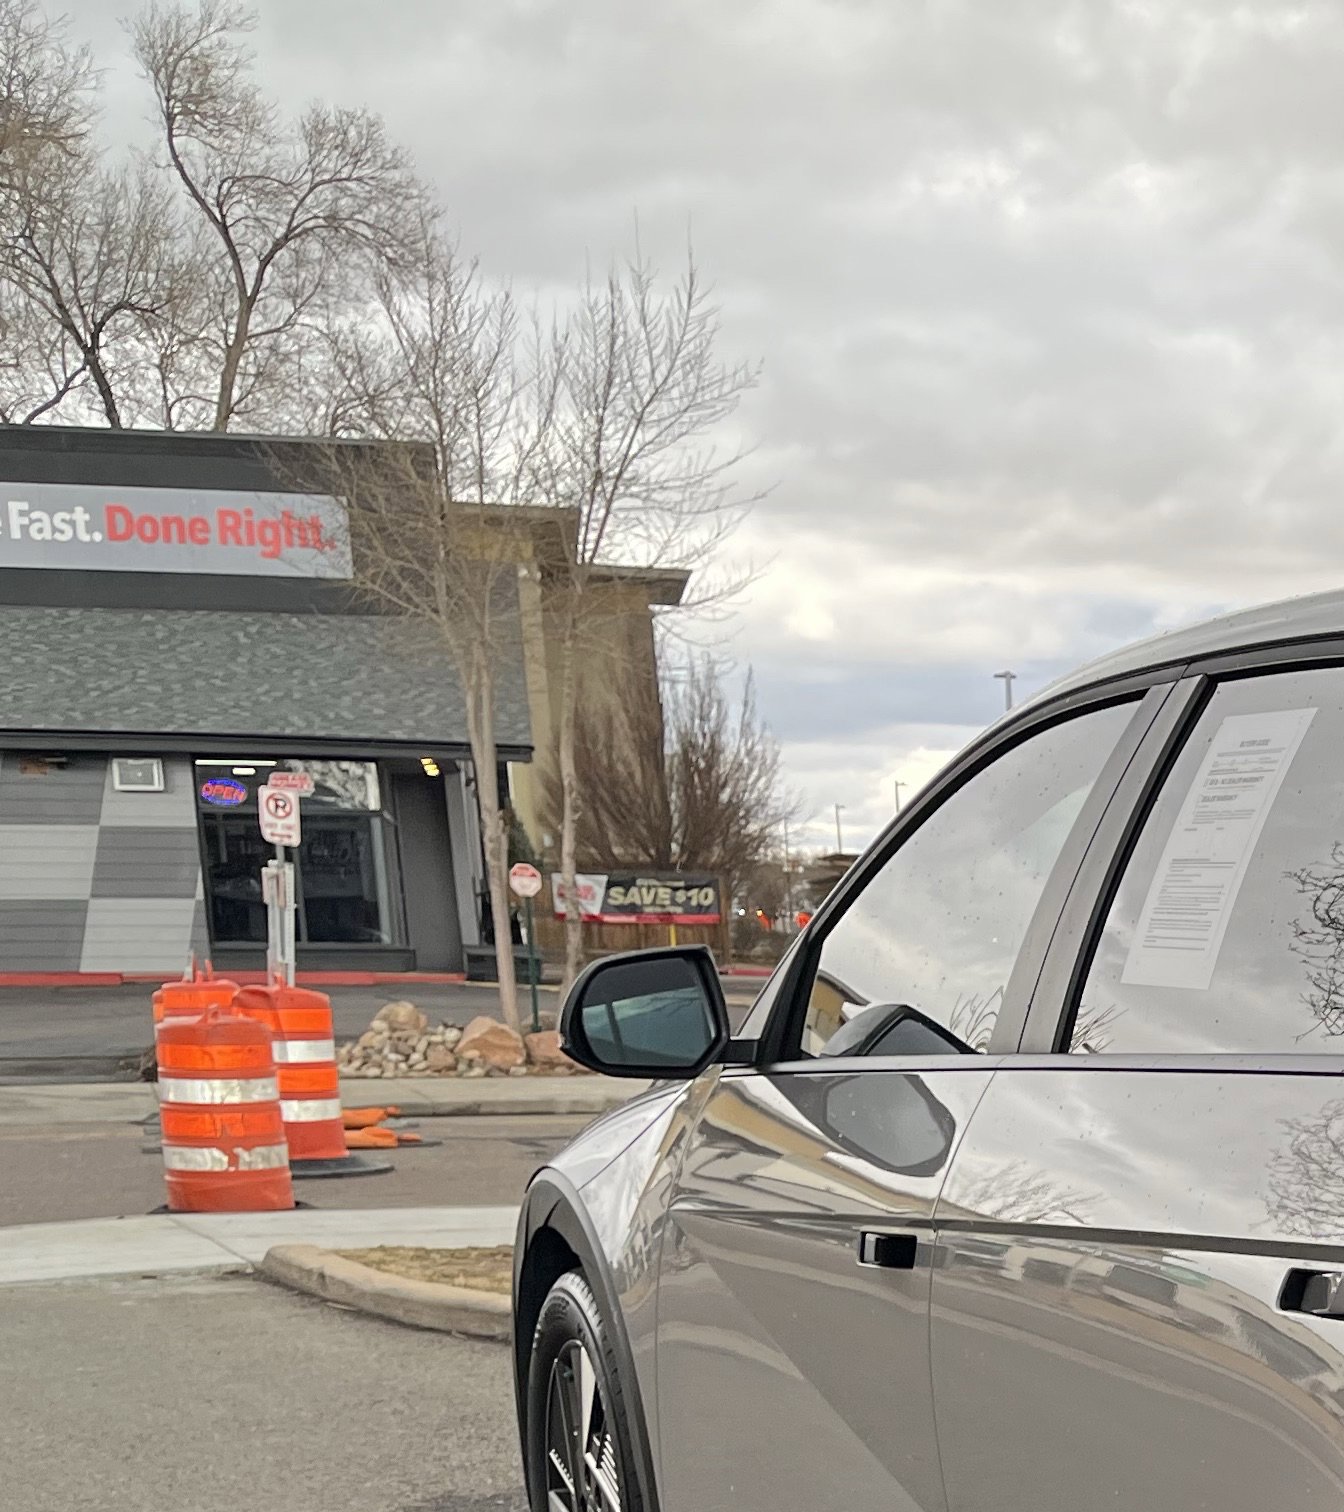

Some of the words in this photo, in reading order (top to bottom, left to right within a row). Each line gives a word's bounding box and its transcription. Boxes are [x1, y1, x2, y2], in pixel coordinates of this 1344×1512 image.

[8, 500, 103, 544] Fast.
[105, 504, 210, 545] Done
[216, 507, 336, 560] Right.
[201, 782, 246, 801] OPEN
[606, 884, 672, 907] SAVE
[674, 886, 715, 907] $10
